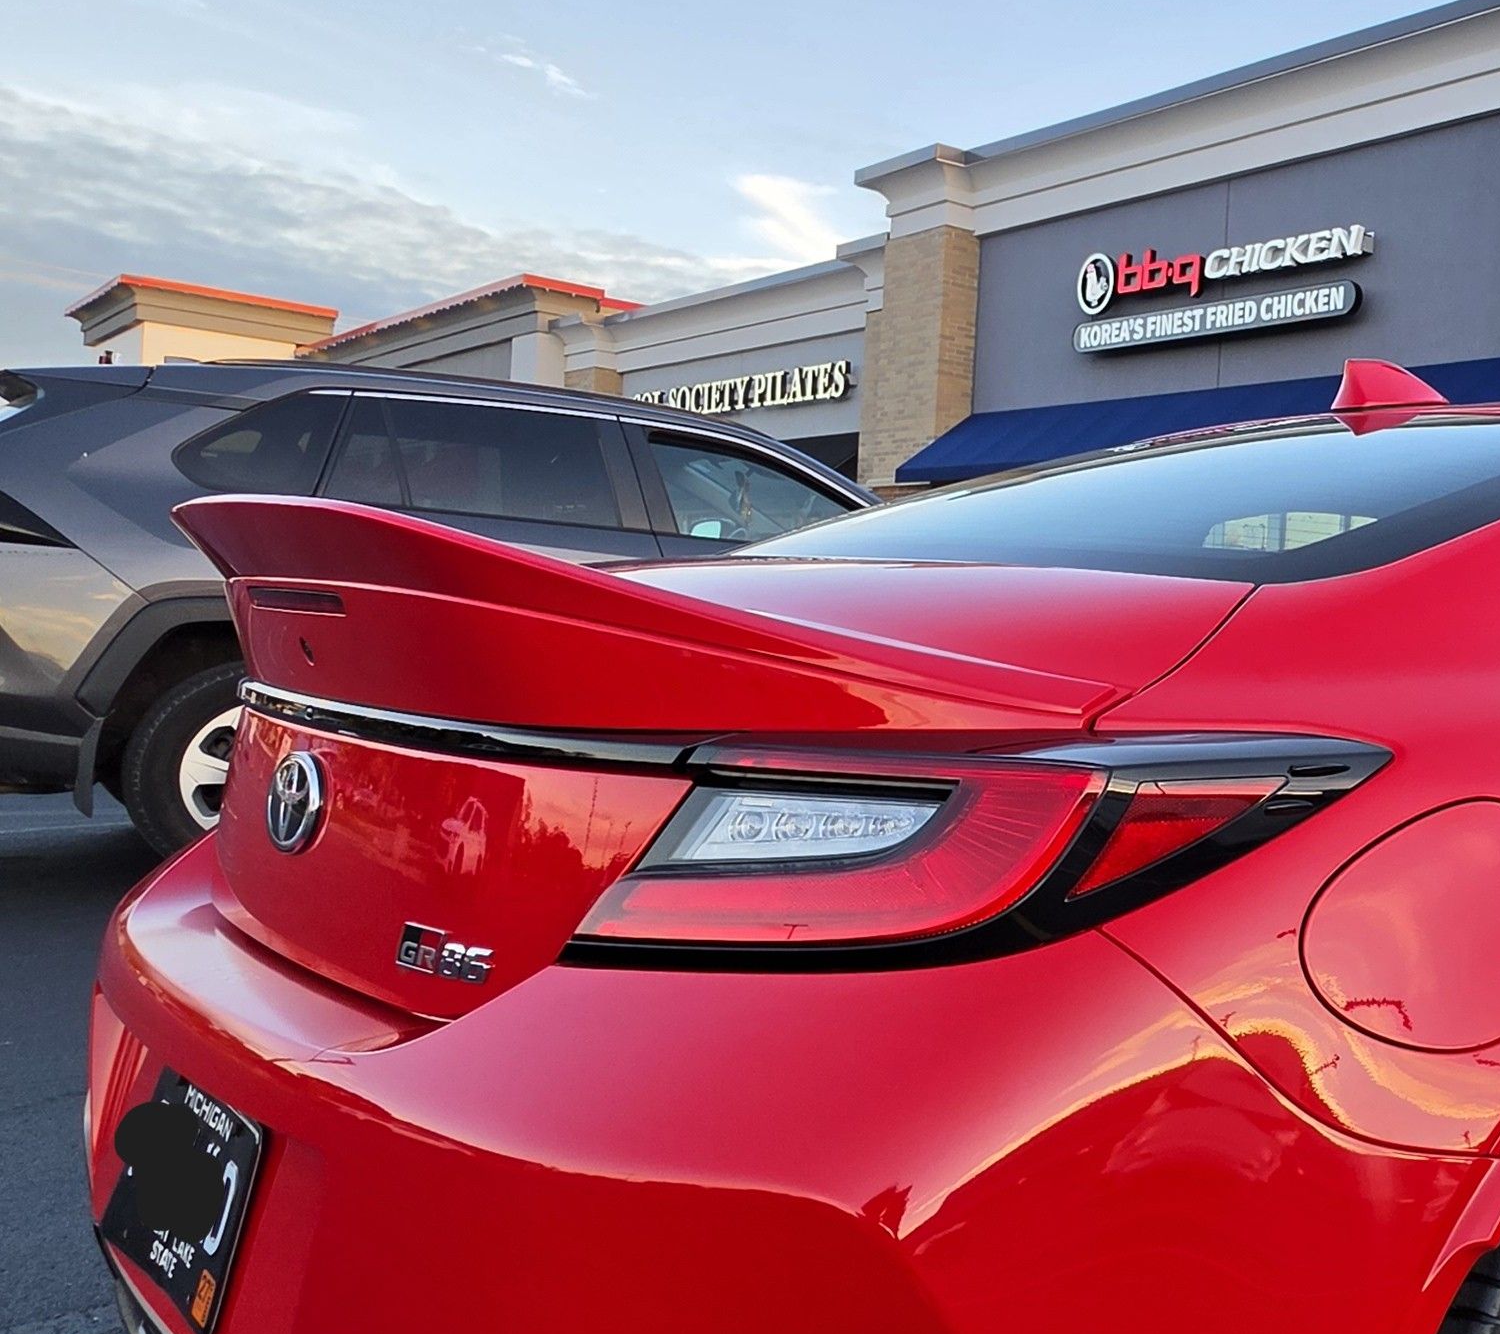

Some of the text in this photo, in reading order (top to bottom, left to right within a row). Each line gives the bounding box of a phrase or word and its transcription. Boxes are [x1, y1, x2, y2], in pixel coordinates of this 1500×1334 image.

[1203, 224, 1372, 280] CHICKEN
[1079, 285, 1346, 349] KOREA'S FINEST FRIED CHICKEN
[668, 375, 751, 415] SOCIETY
[751, 360, 850, 408] PILATES
[399, 940, 437, 970] GR
[183, 1084, 234, 1143] MICHIGAN
[150, 1240, 178, 1279] STATE
[172, 1237, 196, 1269] LAKE
